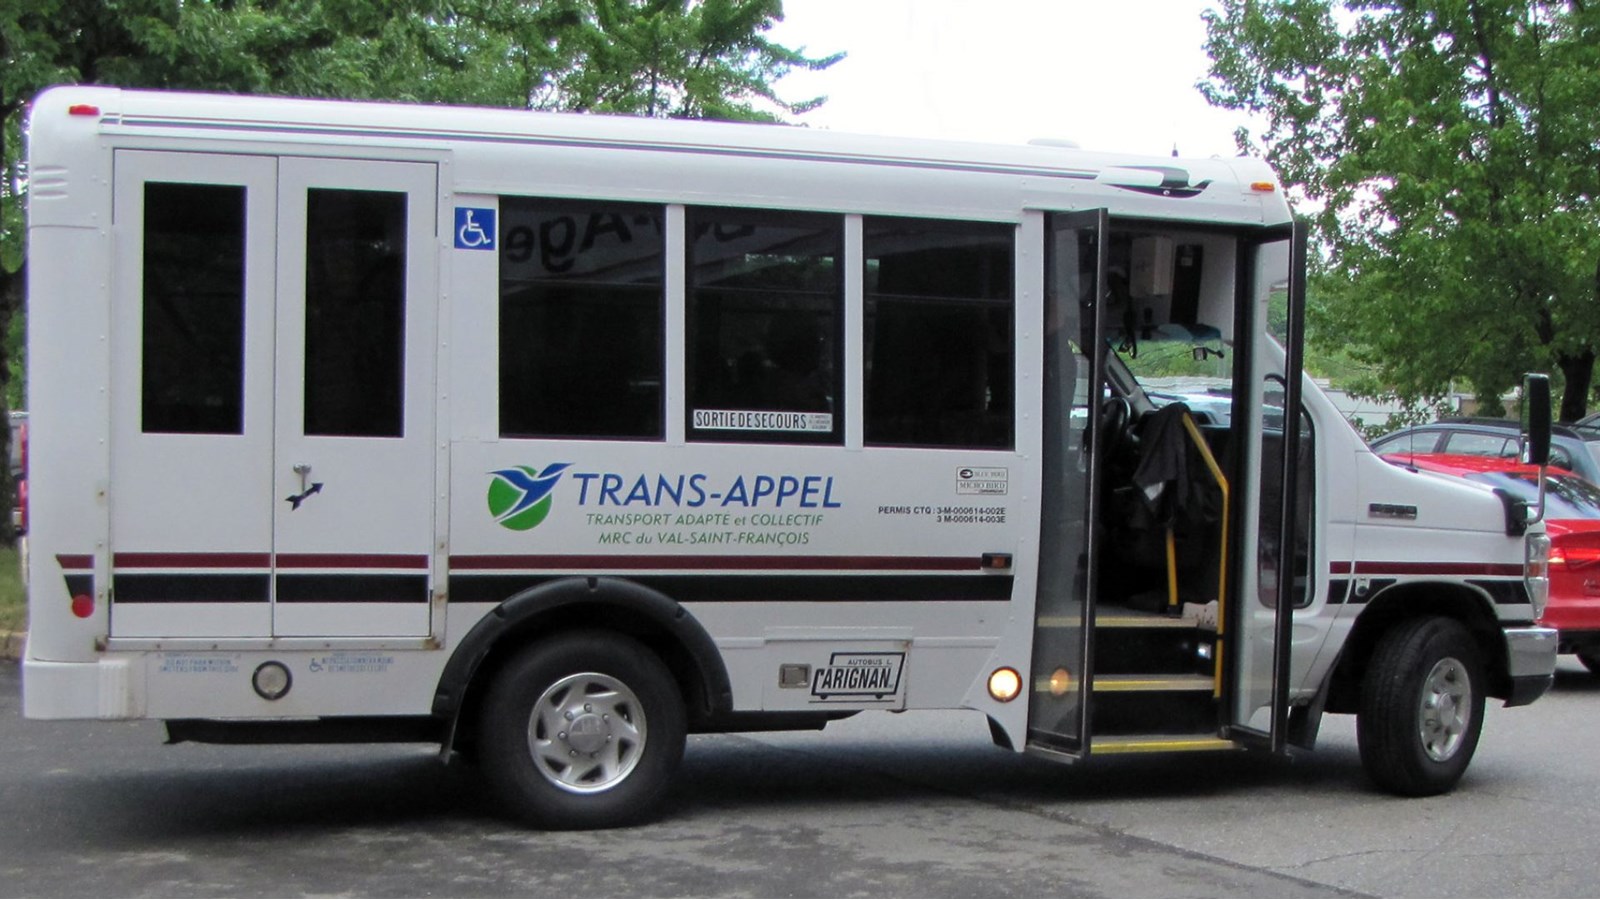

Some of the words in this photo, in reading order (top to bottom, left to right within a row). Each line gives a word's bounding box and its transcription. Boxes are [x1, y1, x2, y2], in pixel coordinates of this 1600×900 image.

[695, 411, 736, 427] SORTIE
[738, 412, 752, 427] DE
[754, 413, 807, 429] SECOURS
[572, 473, 842, 508] TRANS-APPEL
[878, 506, 911, 515] PERMIS
[586, 513, 672, 526] TRANSPORT
[734, 516, 746, 526] et
[750, 514, 824, 527] COLLECTIF
[598, 532, 632, 544] MRC
[636, 533, 652, 544] du
[657, 531, 810, 547] VAL-SAINT-FRANÇOIS
